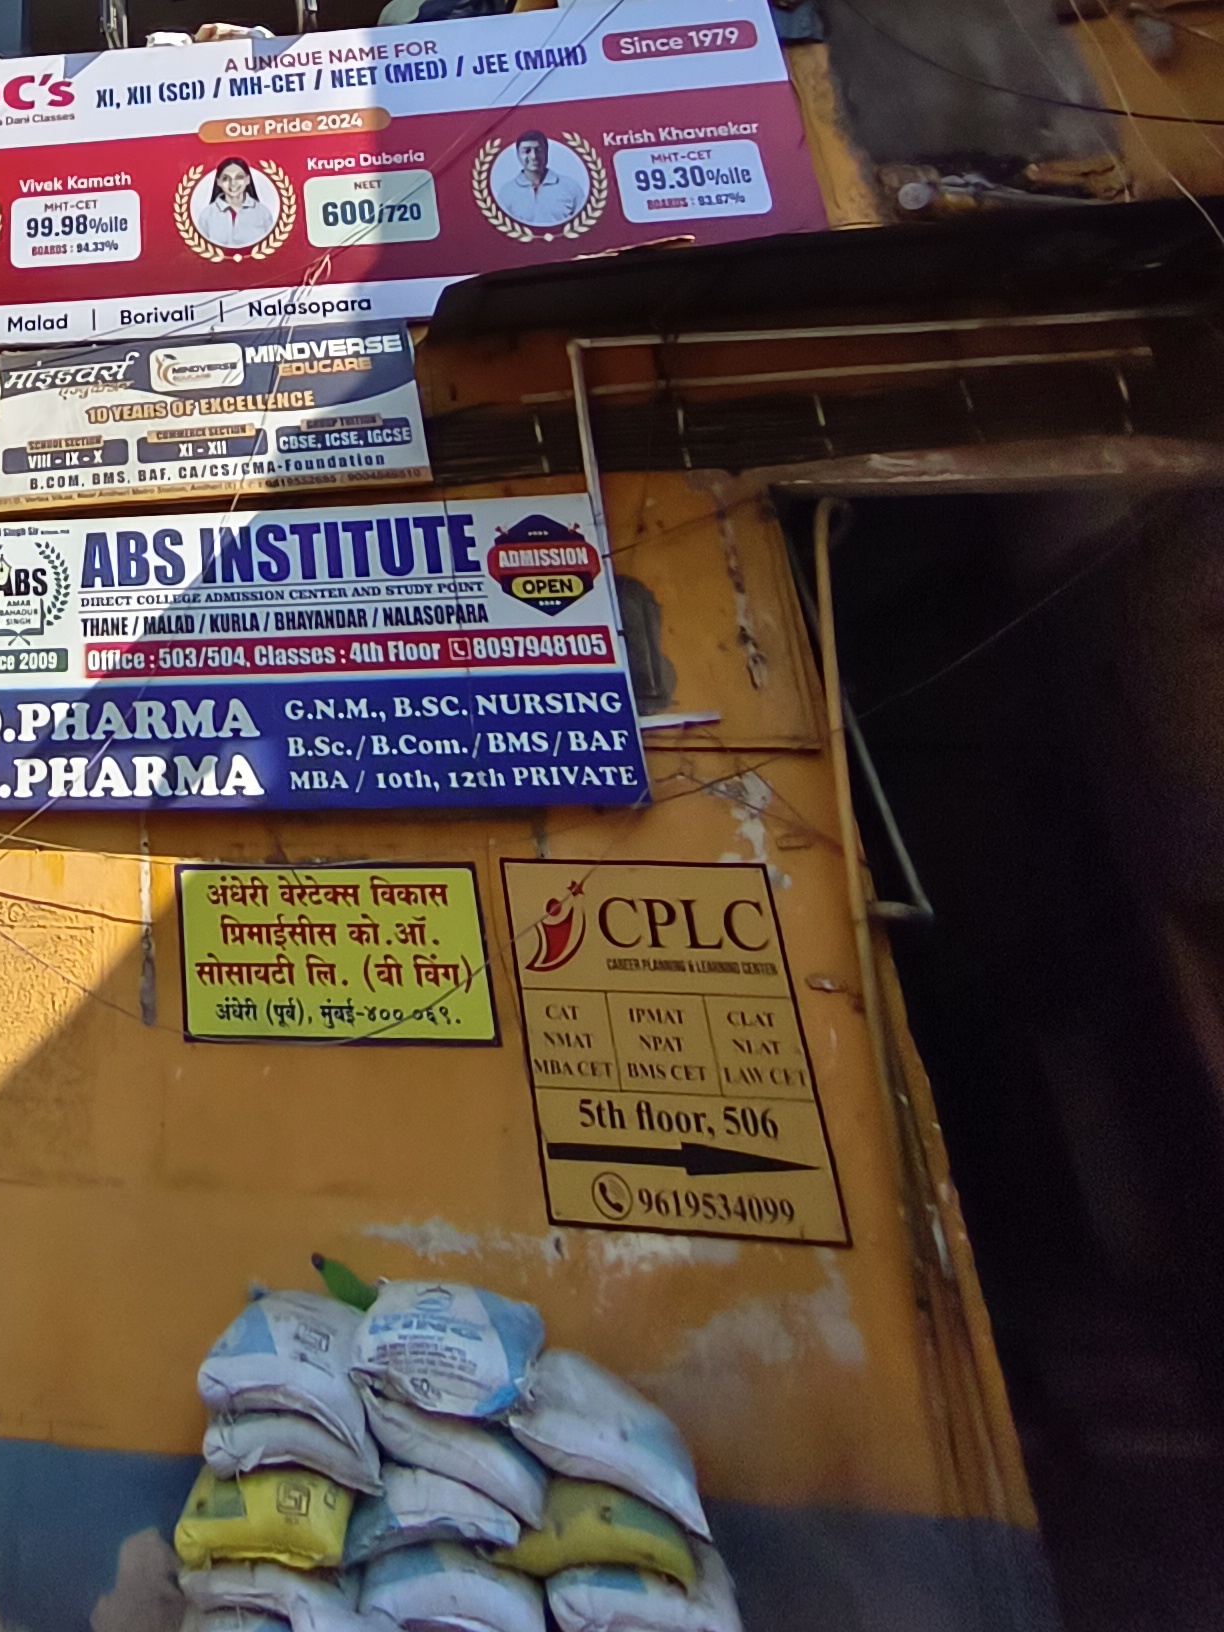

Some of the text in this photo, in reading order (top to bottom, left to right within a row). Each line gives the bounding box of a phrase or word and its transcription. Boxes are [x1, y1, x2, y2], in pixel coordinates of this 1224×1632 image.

[619, 28, 739, 56] Since 1979
[245, 40, 438, 71] UNIQUE NAME FOR
[96, 53, 509, 111] XI, XII (SCI) MH-CET NEET (MED) JEE
[6, 114, 30, 127] Dani
[32, 111, 76, 125] Classes
[226, 113, 364, 138] Our Pride 2024
[602, 122, 760, 147] Krrish Khavnekar
[307, 155, 355, 174] Krupa
[19, 172, 132, 193] Vivek Kamath
[7, 314, 69, 334] Malad
[120, 305, 196, 326] Borivali
[247, 294, 373, 320] Nalasopara
[245, 334, 403, 366] MINDVERSE
[278, 357, 373, 377] EDUCARE
[86, 390, 316, 424] 10 YEARS OF EXCELLENCE
[368, 427, 412, 444] IGCSE
[80, 514, 483, 589] ABS INSTITUTE
[498, 547, 589, 568] ADMISSION
[81, 580, 485, 608] DIRECT COLLEGE ADMISSION CENTER AND STUDY POINT
[521, 578, 574, 595] OPEN
[81, 602, 490, 638] THANE MALAD KURLA BHAYANDAR NALASOPARA
[18, 651, 58, 671] 2009
[87, 648, 146, 672] Office
[254, 642, 336, 667] Classes
[349, 641, 383, 664] 4th
[387, 639, 442, 662] Floor
[472, 632, 608, 660] 8097948105
[283, 691, 624, 723] G.N.M., B.SC. NURSING
[488, 730, 629, 754] BMS BAF
[289, 769, 350, 790] MBA
[448, 766, 506, 788] 12th
[512, 764, 639, 787] PRIVATE
[207, 875, 448, 908] अंधेरी विकास
[221, 913, 337, 951] प्रिमाईसीस
[597, 896, 771, 952] CPLC
[215, 997, 258, 1023] अंधेरी
[545, 1004, 579, 1022] CAT
[628, 1007, 685, 1026] IPMAT
[725, 1010, 775, 1028] CLAT
[543, 1032, 594, 1050] NMAT
[639, 1034, 684, 1053] NPAT
[533, 1058, 614, 1079] MBA CET
[627, 1062, 708, 1082] BMS CET
[725, 1066, 764, 1085] LAW
[578, 1098, 779, 1140] 5th floor, 506
[637, 1187, 796, 1225] 9619534099
